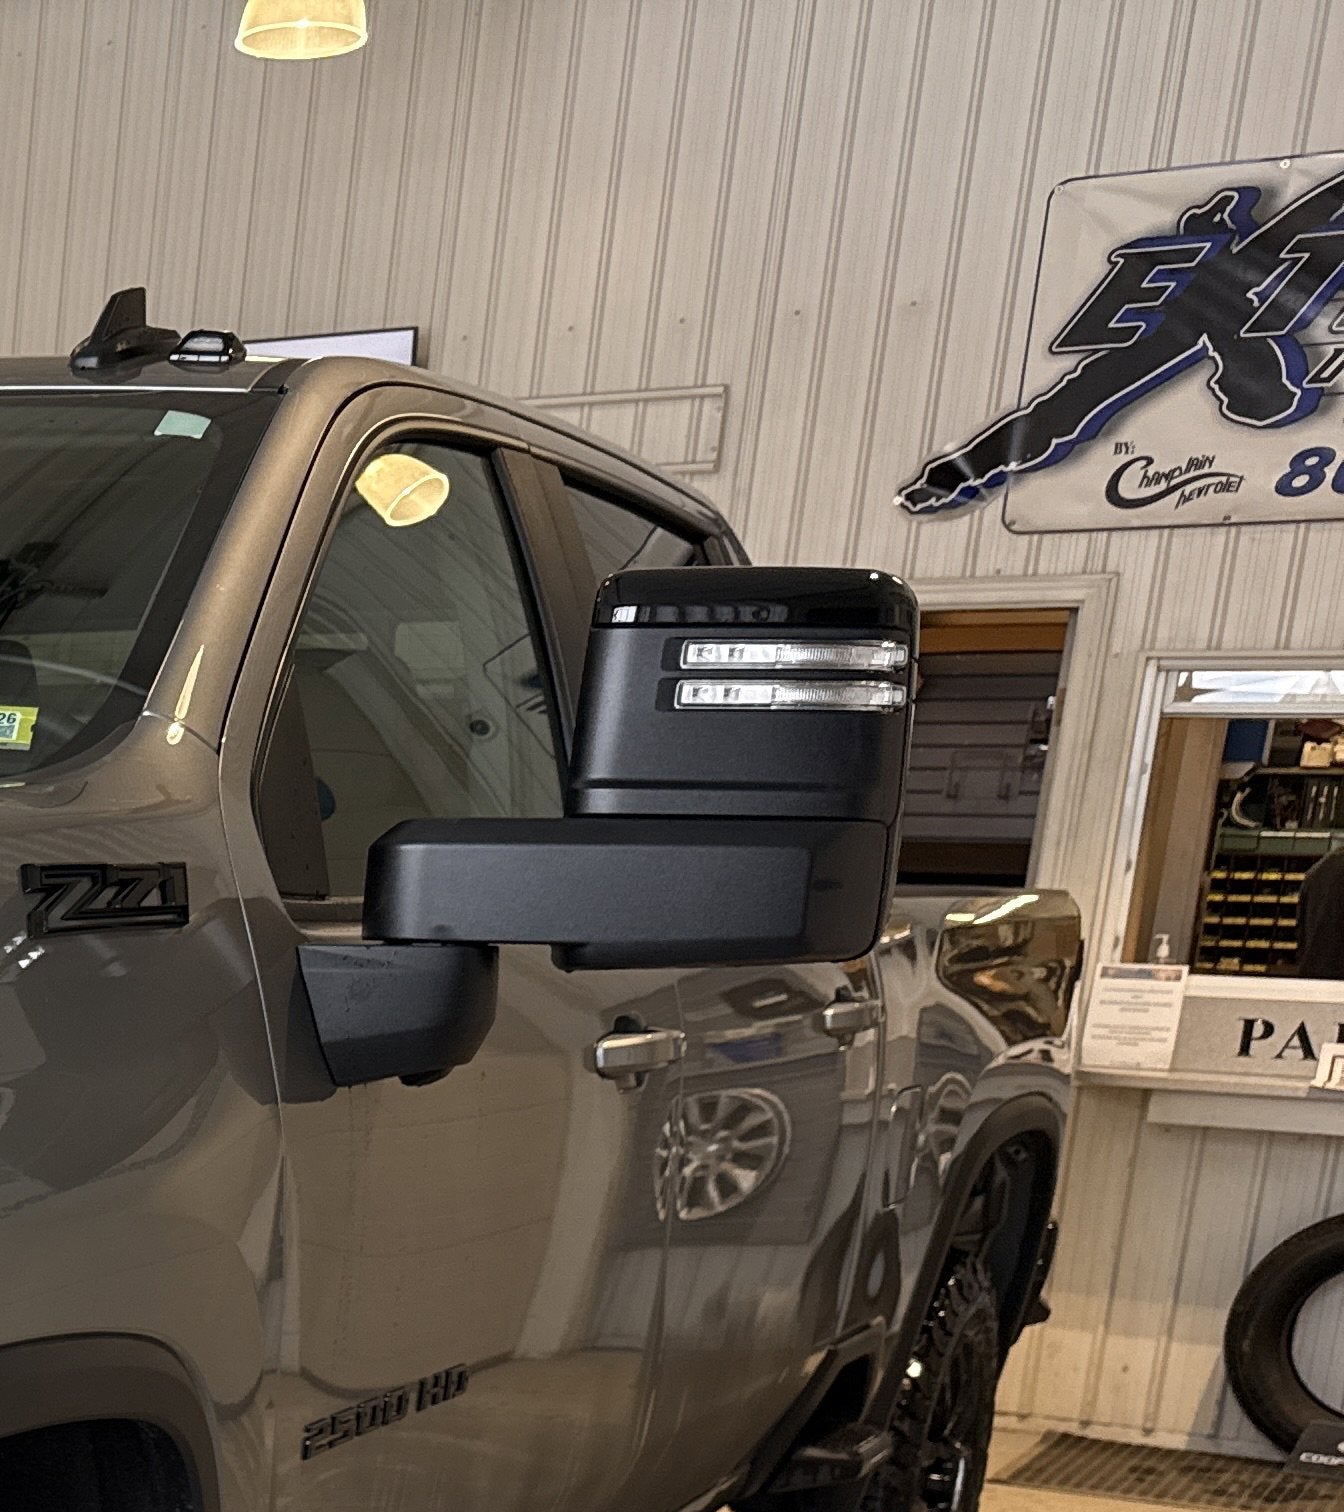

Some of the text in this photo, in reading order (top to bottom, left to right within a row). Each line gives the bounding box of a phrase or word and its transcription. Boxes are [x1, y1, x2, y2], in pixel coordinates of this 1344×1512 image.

[1113, 440, 1137, 455] BY:
[1274, 446, 1344, 497] 8
[20, 862, 190, 939] Z71
[1234, 1016, 1344, 1062] PA
[300, 1363, 471, 1461] 2500 HD
